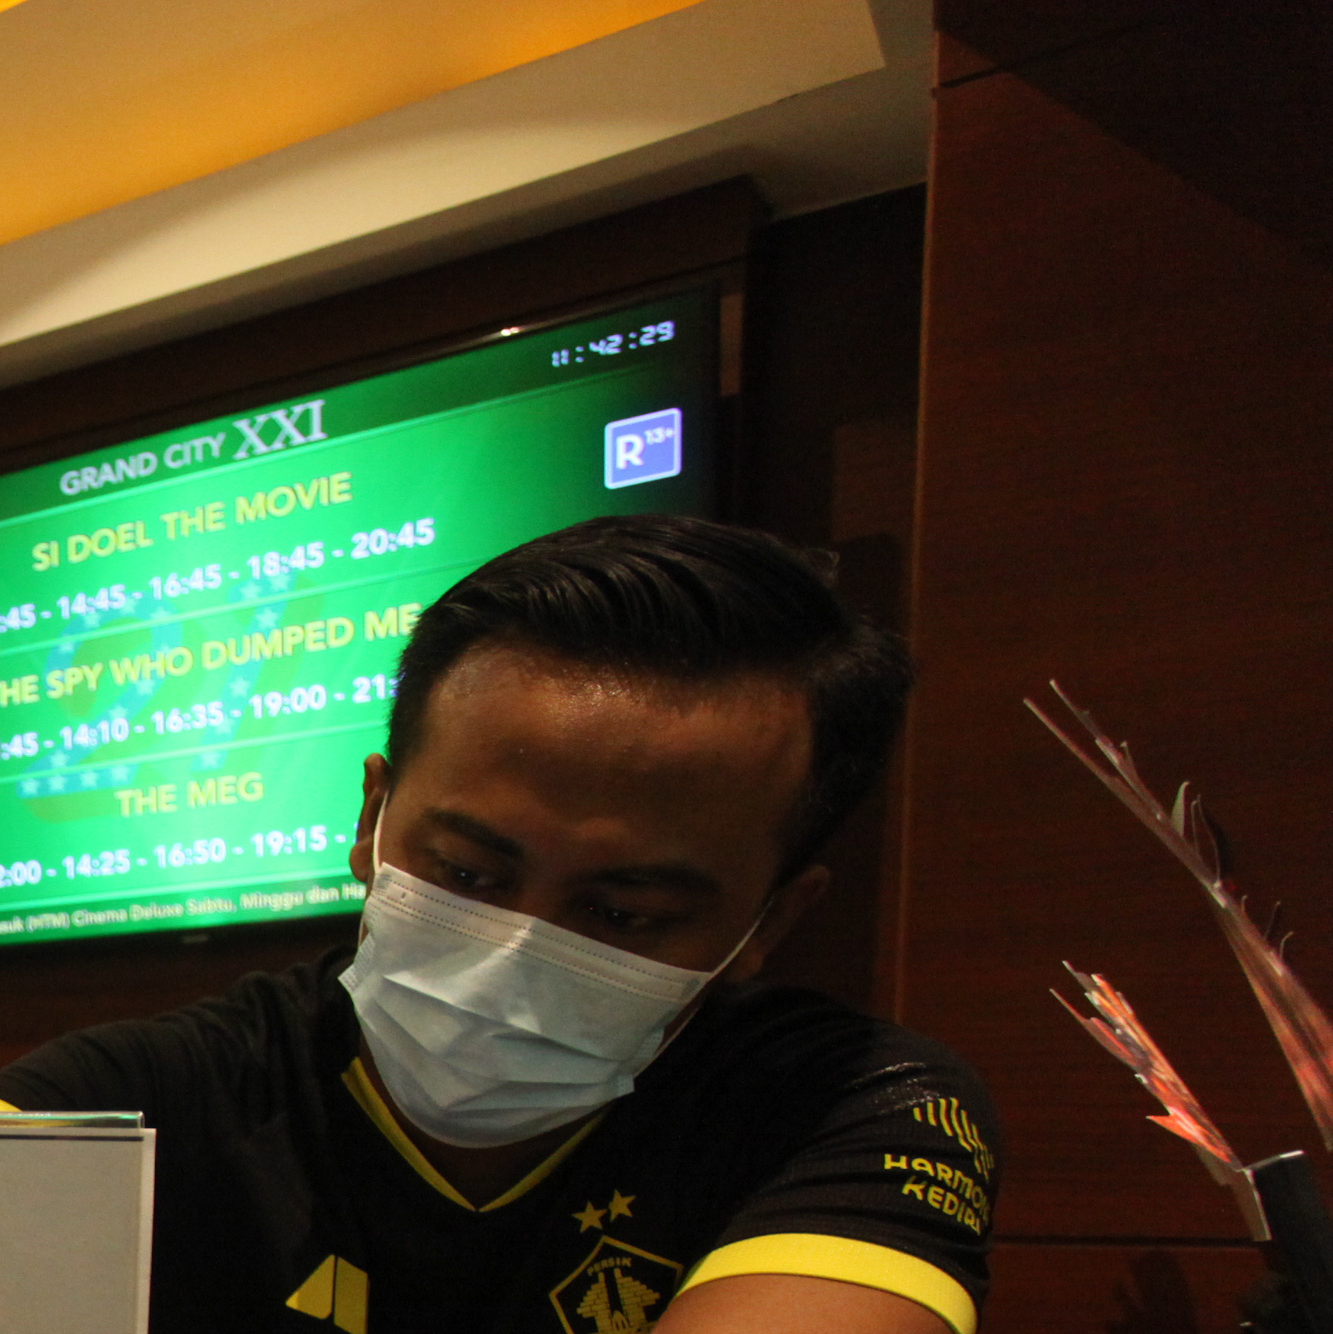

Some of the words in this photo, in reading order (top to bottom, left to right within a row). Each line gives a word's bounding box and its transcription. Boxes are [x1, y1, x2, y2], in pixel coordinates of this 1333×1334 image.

[60, 451, 157, 495] GRAND
[165, 433, 225, 468] CITY
[234, 400, 328, 459] XXI
[32, 541, 60, 572] SI
[67, 520, 153, 564] DOEL
[160, 501, 225, 540] THE
[235, 472, 353, 524] MOVIE
[57, 584, 126, 620] 14:45
[149, 564, 222, 598] 16:45
[247, 542, 324, 579] 18:45
[351, 518, 435, 560] 20:45
[46, 662, 103, 699] SPY
[110, 646, 193, 686] WHO
[201, 618, 355, 670] DUMPED
[364, 603, 422, 641] ME
[59, 717, 130, 749] 14:10
[151, 701, 225, 735] 16:35
[248, 684, 327, 719] 19:00
[352, 675, 399, 702] 21:
[114, 785, 177, 818] THE
[186, 772, 264, 807] MEG
[62, 849, 131, 878] 14:25
[153, 837, 226, 868] 16:50
[251, 825, 327, 858] 19:15
[587, 1256, 632, 1277] PERSIK
